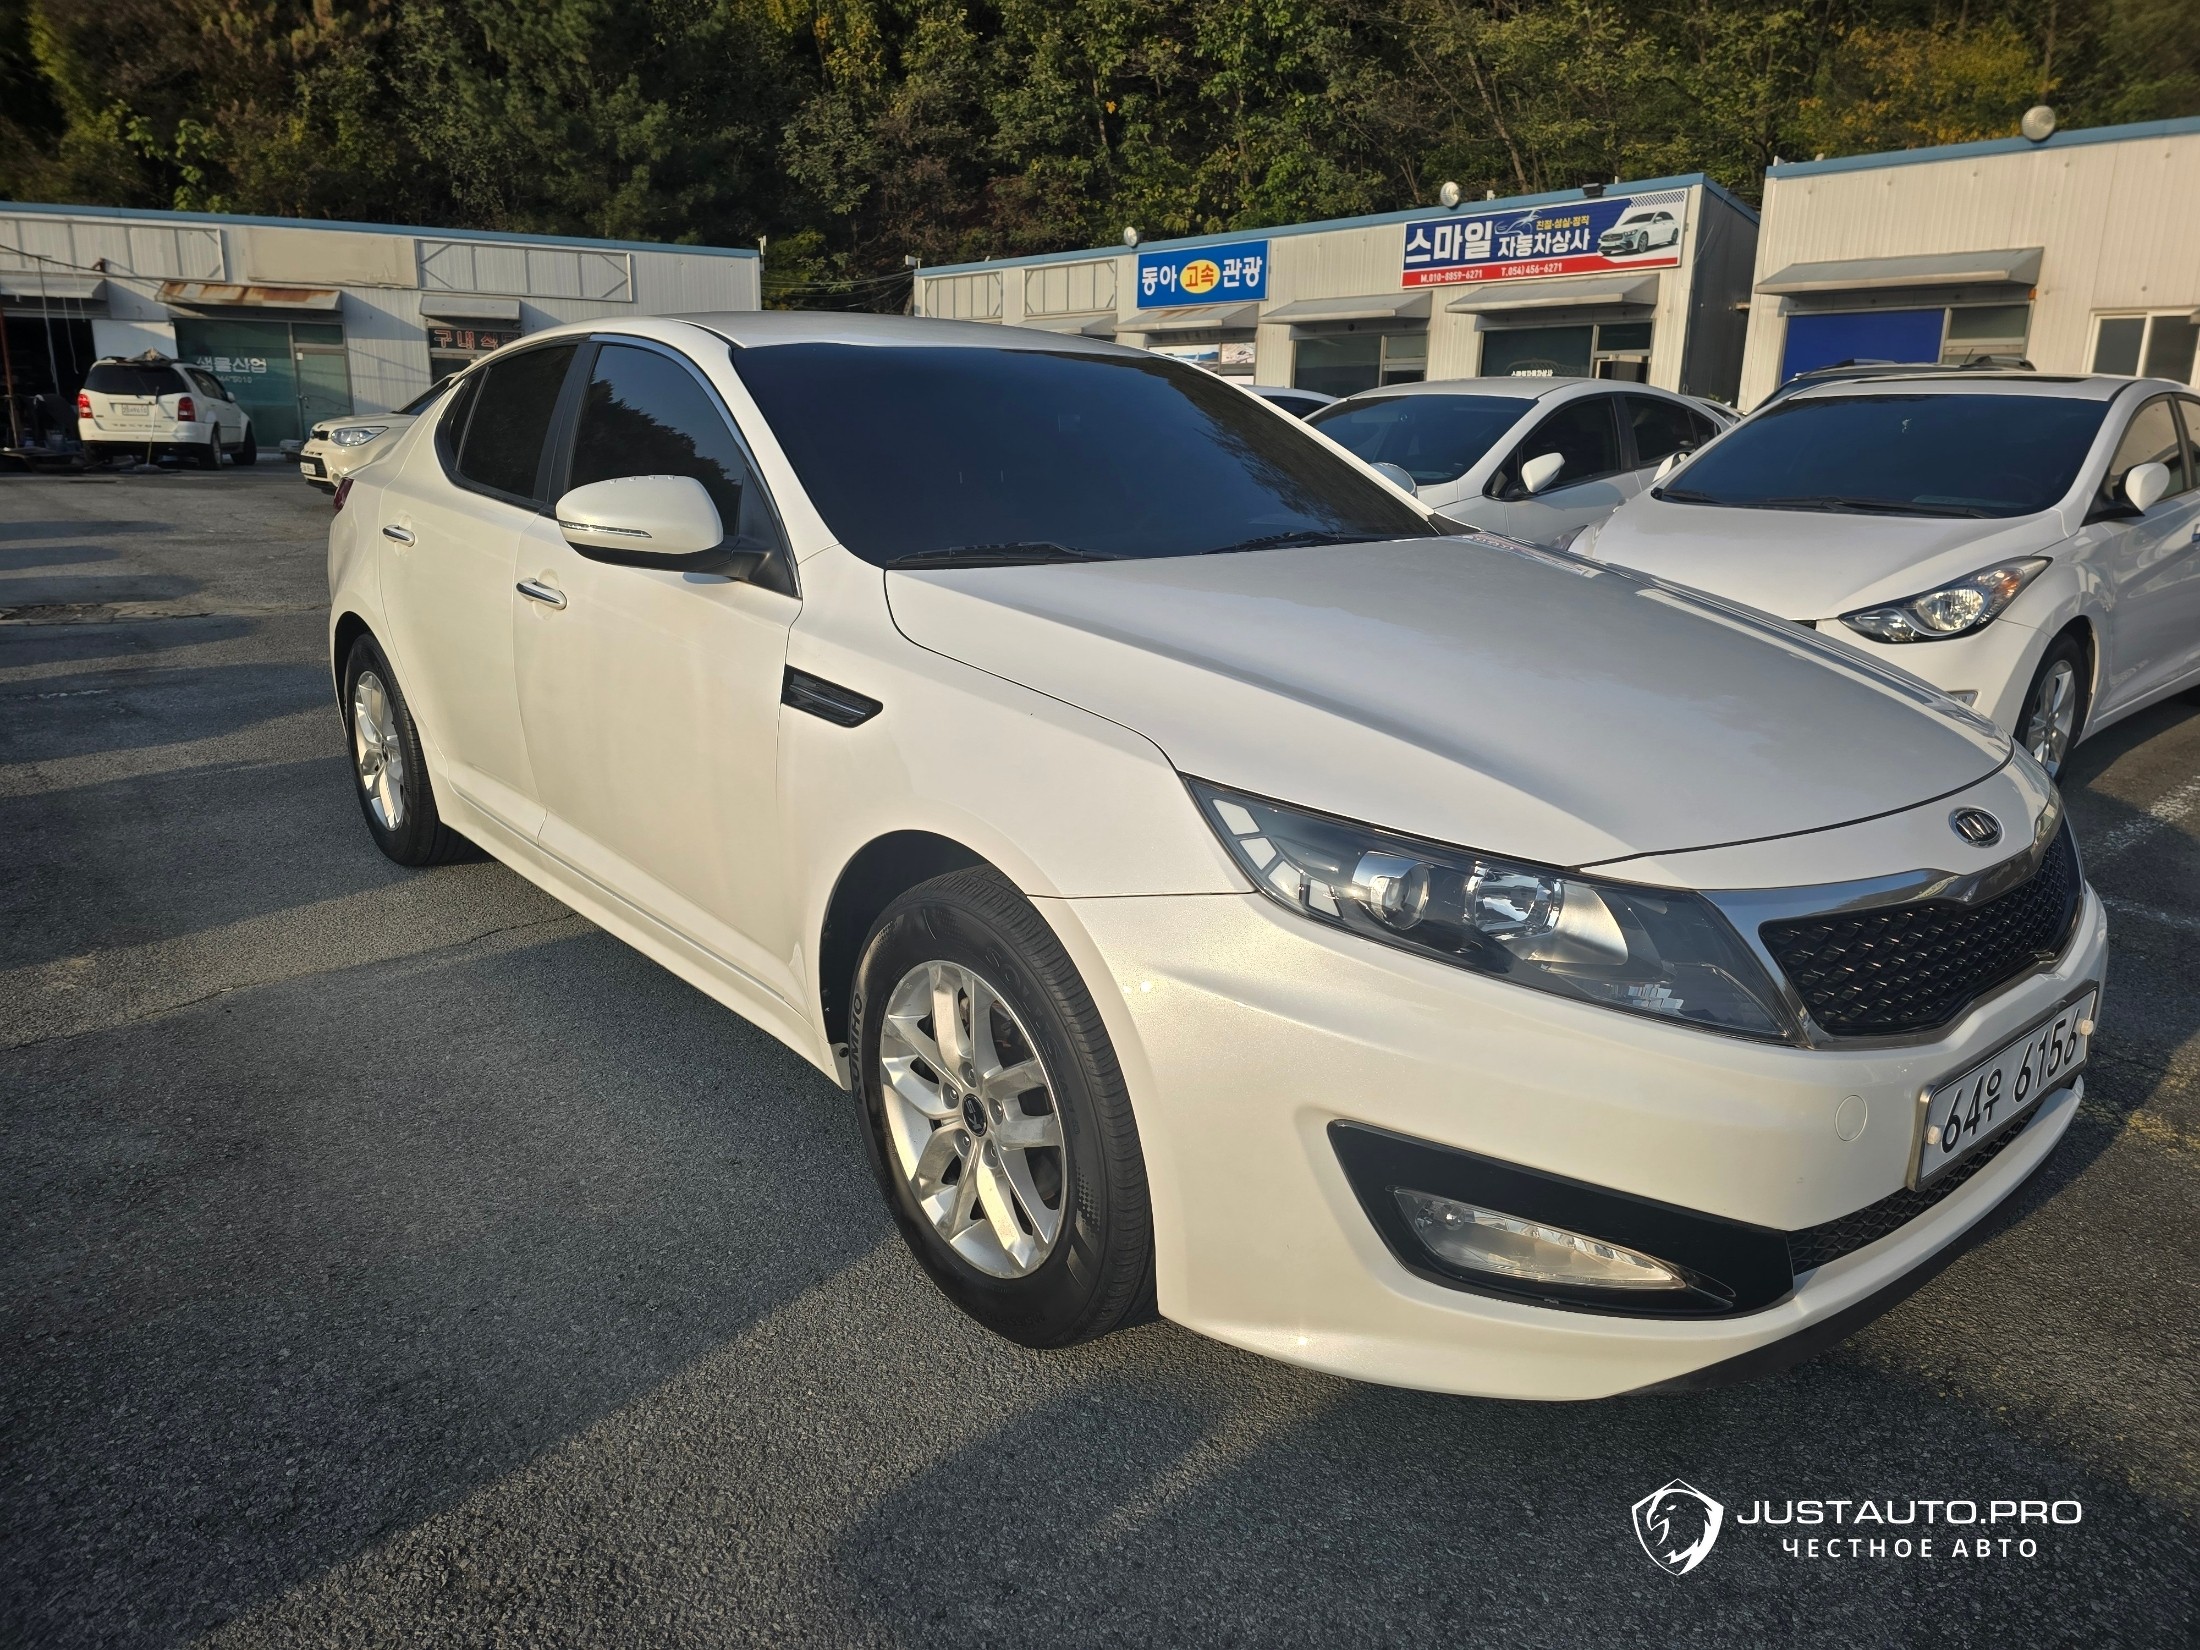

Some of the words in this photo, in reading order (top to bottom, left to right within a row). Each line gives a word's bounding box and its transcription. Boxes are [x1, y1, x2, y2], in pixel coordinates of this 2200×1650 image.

[1405, 220, 1494, 263] 스마일
[1497, 228, 1591, 258] 자동차상사
[1142, 265, 1178, 296] 동아
[1185, 264, 1214, 288] 고속
[1222, 256, 1263, 288] 관광
[849, 992, 864, 1105] KUMHO
[1941, 1068, 2003, 1154] 64우
[2013, 1007, 2081, 1103] 6156
